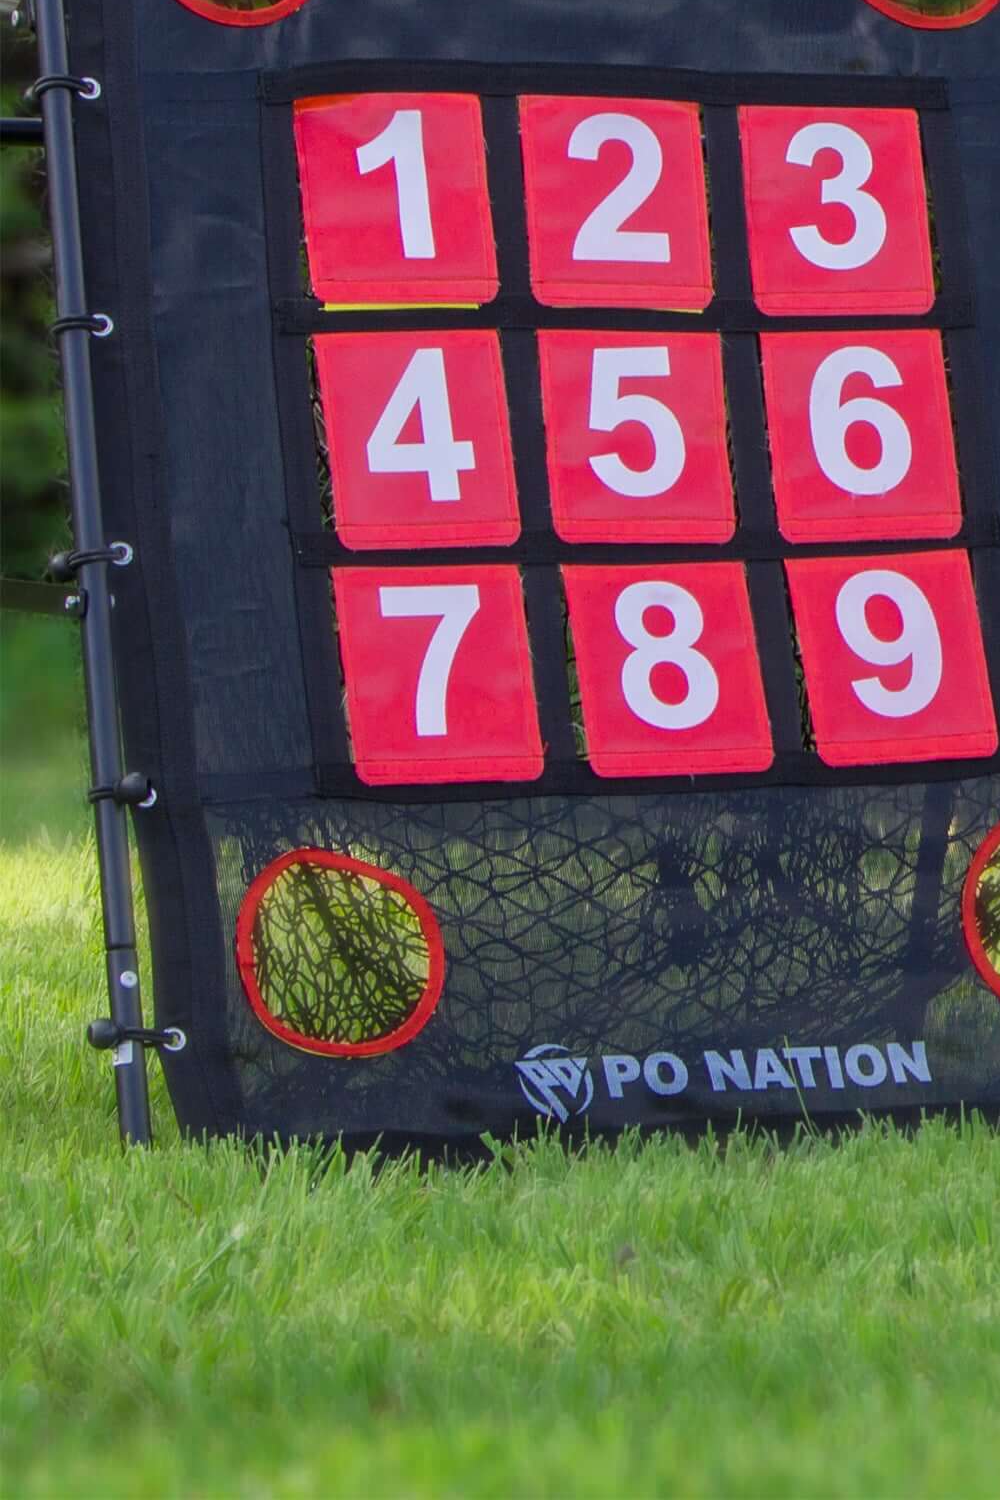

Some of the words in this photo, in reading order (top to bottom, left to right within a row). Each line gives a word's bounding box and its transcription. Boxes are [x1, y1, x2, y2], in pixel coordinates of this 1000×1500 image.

[356, 110, 436, 259] 1
[567, 112, 671, 263] 2
[785, 121, 888, 271] 3
[366, 347, 477, 501] 4
[588, 345, 687, 497] 5
[808, 345, 913, 496] 6
[379, 584, 481, 737] 7
[614, 580, 720, 730] 8
[835, 569, 943, 718] 9
[601, 1050, 689, 1098] PO
[703, 1040, 933, 1092] NATION
